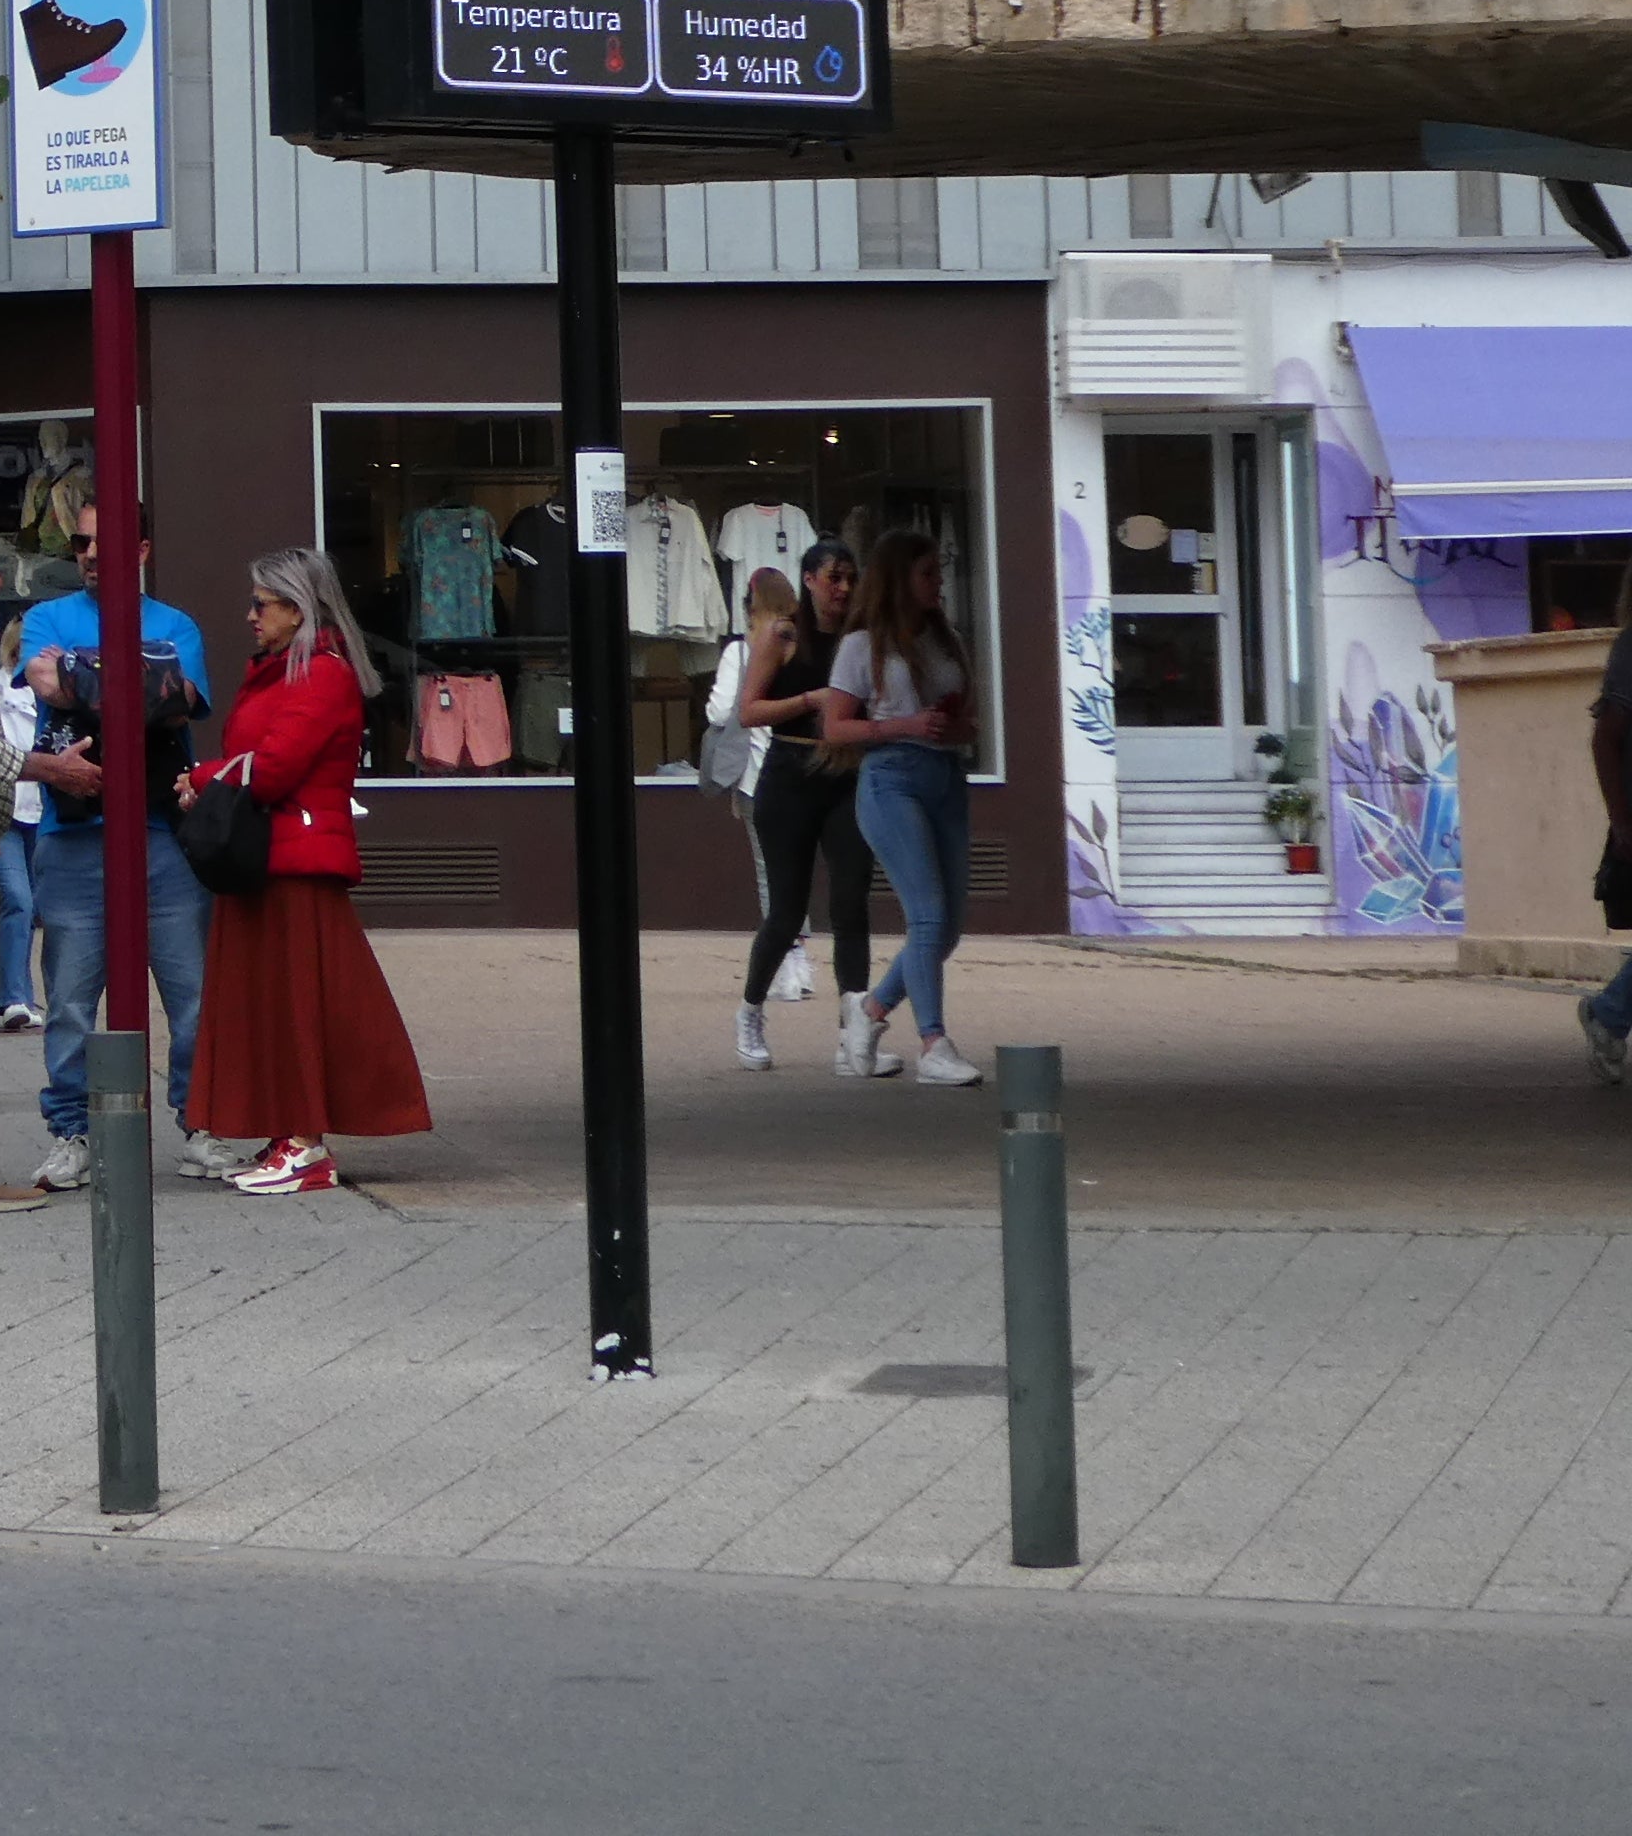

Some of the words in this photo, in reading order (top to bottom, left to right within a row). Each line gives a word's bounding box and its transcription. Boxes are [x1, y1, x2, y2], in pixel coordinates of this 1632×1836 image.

[685, 9, 806, 41] Humedad
[490, 46, 526, 74] 21
[696, 54, 729, 82] 34
[737, 56, 802, 85] %HR
[47, 131, 62, 148] LO
[65, 129, 91, 146] QUE
[93, 127, 127, 144] PEGA
[46, 155, 62, 171] ES
[64, 152, 118, 170] TIRARLO
[120, 150, 130, 165] A
[46, 178, 62, 195] LA
[64, 172, 131, 193] PAPELERA
[1074, 481, 1086, 499] 2
